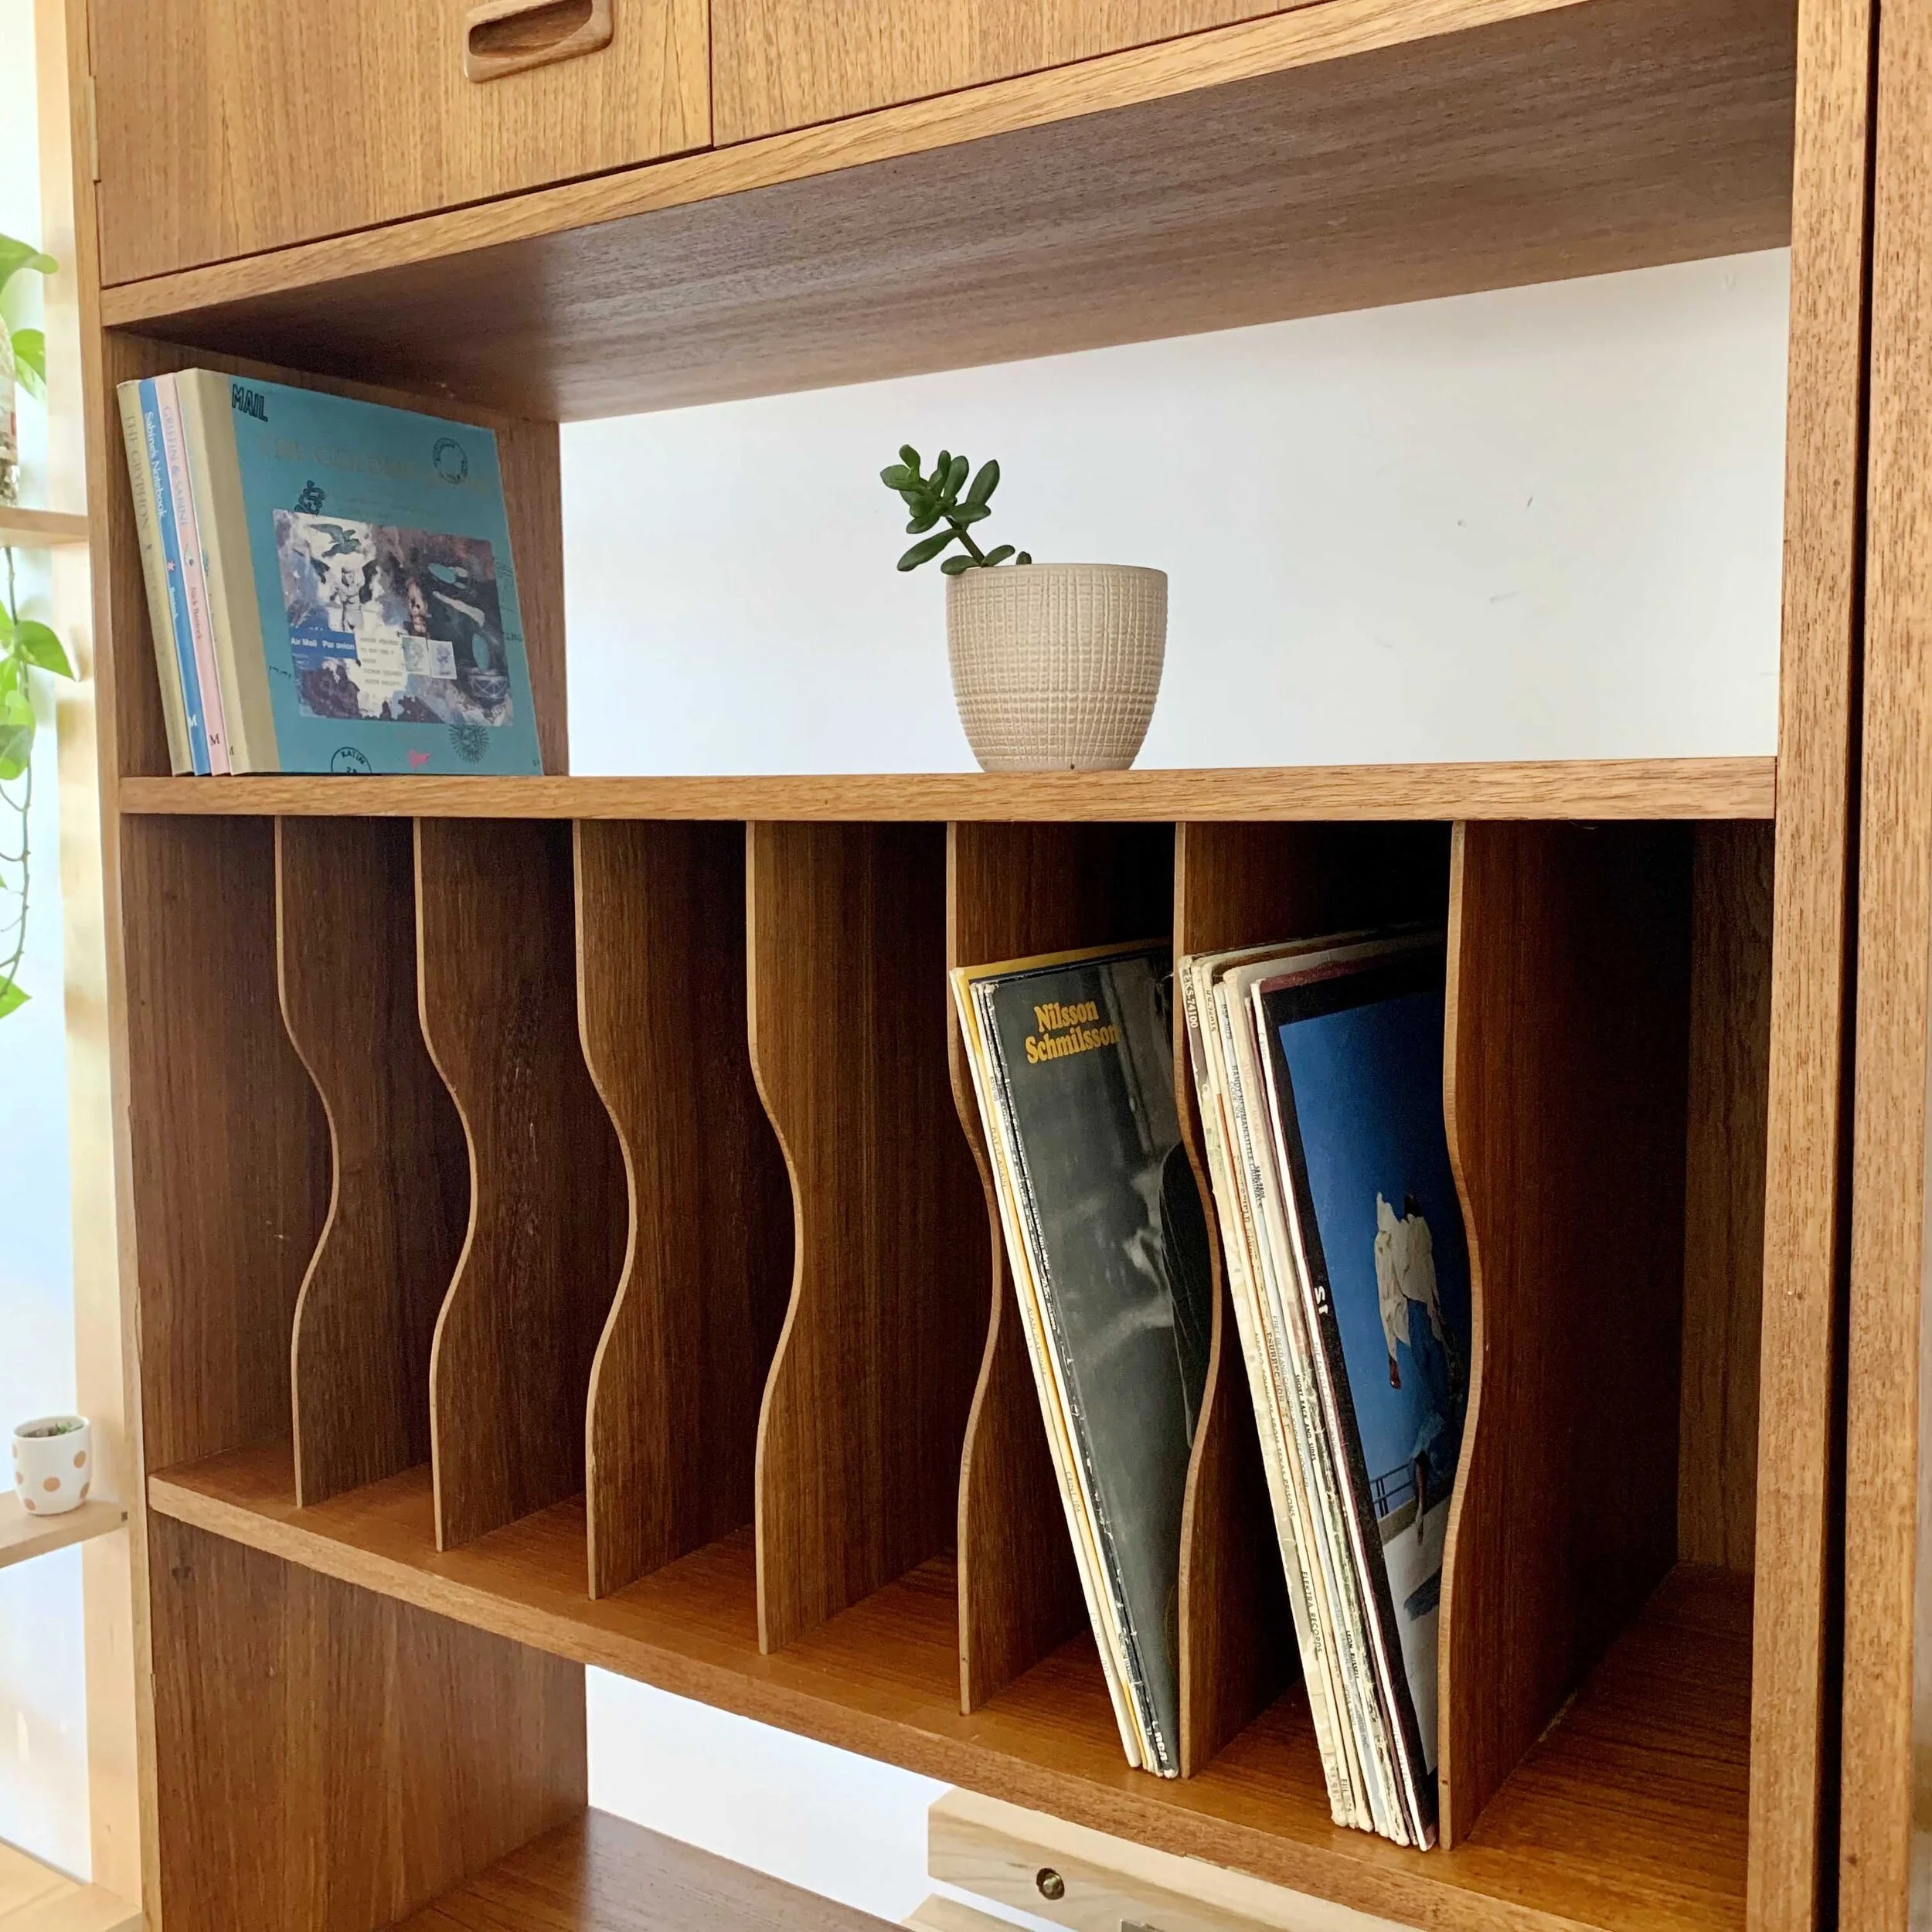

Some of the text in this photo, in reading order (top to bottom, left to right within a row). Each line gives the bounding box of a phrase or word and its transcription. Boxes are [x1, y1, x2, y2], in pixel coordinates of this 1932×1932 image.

[232, 383, 269, 423] MAIL
[160, 406, 182, 461] GRIFFIN
[124, 413, 154, 529] THE GRYPHON
[169, 464, 182, 476] &
[148, 461, 169, 519] Notebook
[302, 638, 318, 647] Mail
[186, 713, 199, 726] M
[209, 733, 221, 745] M
[1033, 1001, 1100, 1032] Nilsson
[1025, 1022, 1120, 1064] Schmilsson
[1231, 1064, 1242, 1093] RANDY
[996, 1159, 1009, 1187] AGAIN
[1312, 1341, 1321, 1355] THE
[1315, 1360, 1325, 1374] END
[1295, 1374, 1318, 1461] SHORT BACK AND SIDES
[1283, 1478, 1295, 1518] PRISONS
[1301, 1570, 1323, 1653] ELEKTRA RECORDS
[1345, 1630, 1360, 1679] LEON RUSSELL
[1154, 1733, 1168, 1761] RCA
